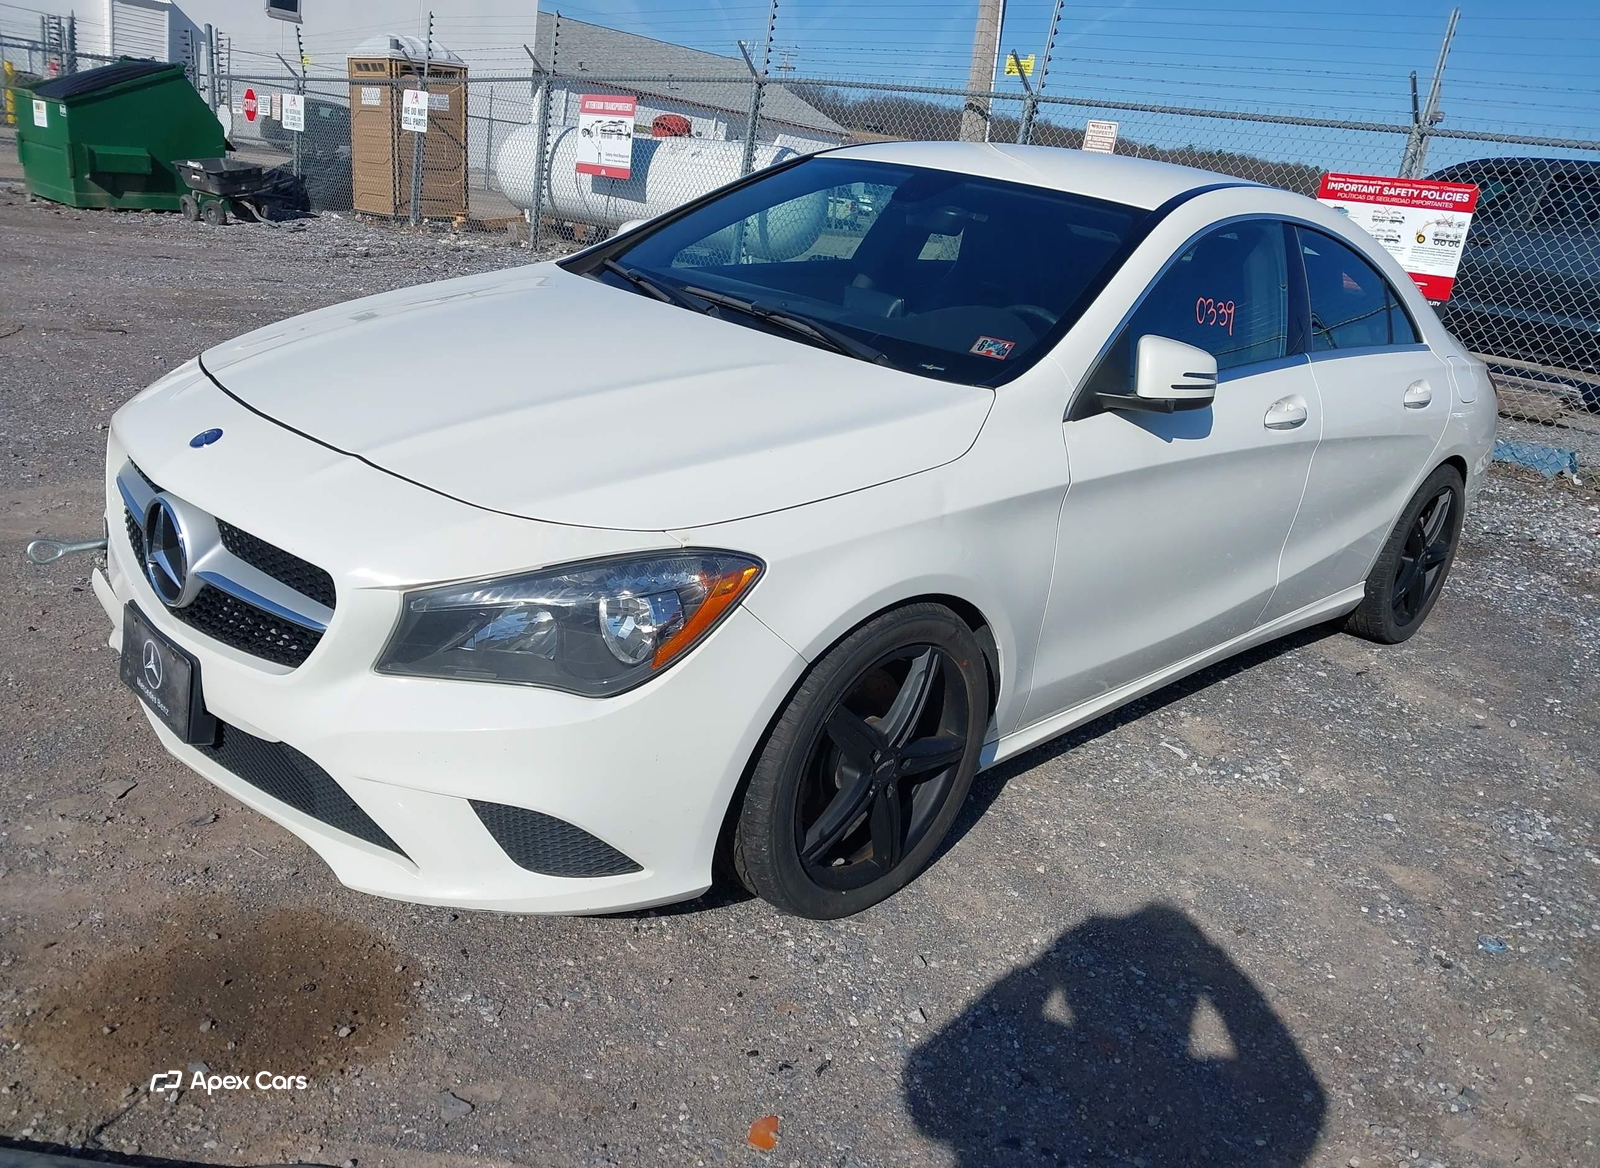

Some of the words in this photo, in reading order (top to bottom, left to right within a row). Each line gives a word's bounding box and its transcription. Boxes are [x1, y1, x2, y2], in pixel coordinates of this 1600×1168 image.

[245, 99, 256, 112] STOP
[404, 106, 410, 115] WE
[411, 107, 417, 115] DO
[418, 108, 426, 117] NOT
[403, 117, 412, 126] SELL
[413, 117, 426, 127] PARTS
[1327, 182, 1382, 194] IMPORTANT
[1382, 185, 1420, 198] SAFETY
[1421, 189, 1470, 202] POLICIES
[1375, 195, 1410, 204] SEGURIDAD
[1411, 198, 1453, 208] IMPORTANTES
[1196, 297, 1235, 336] 0339
